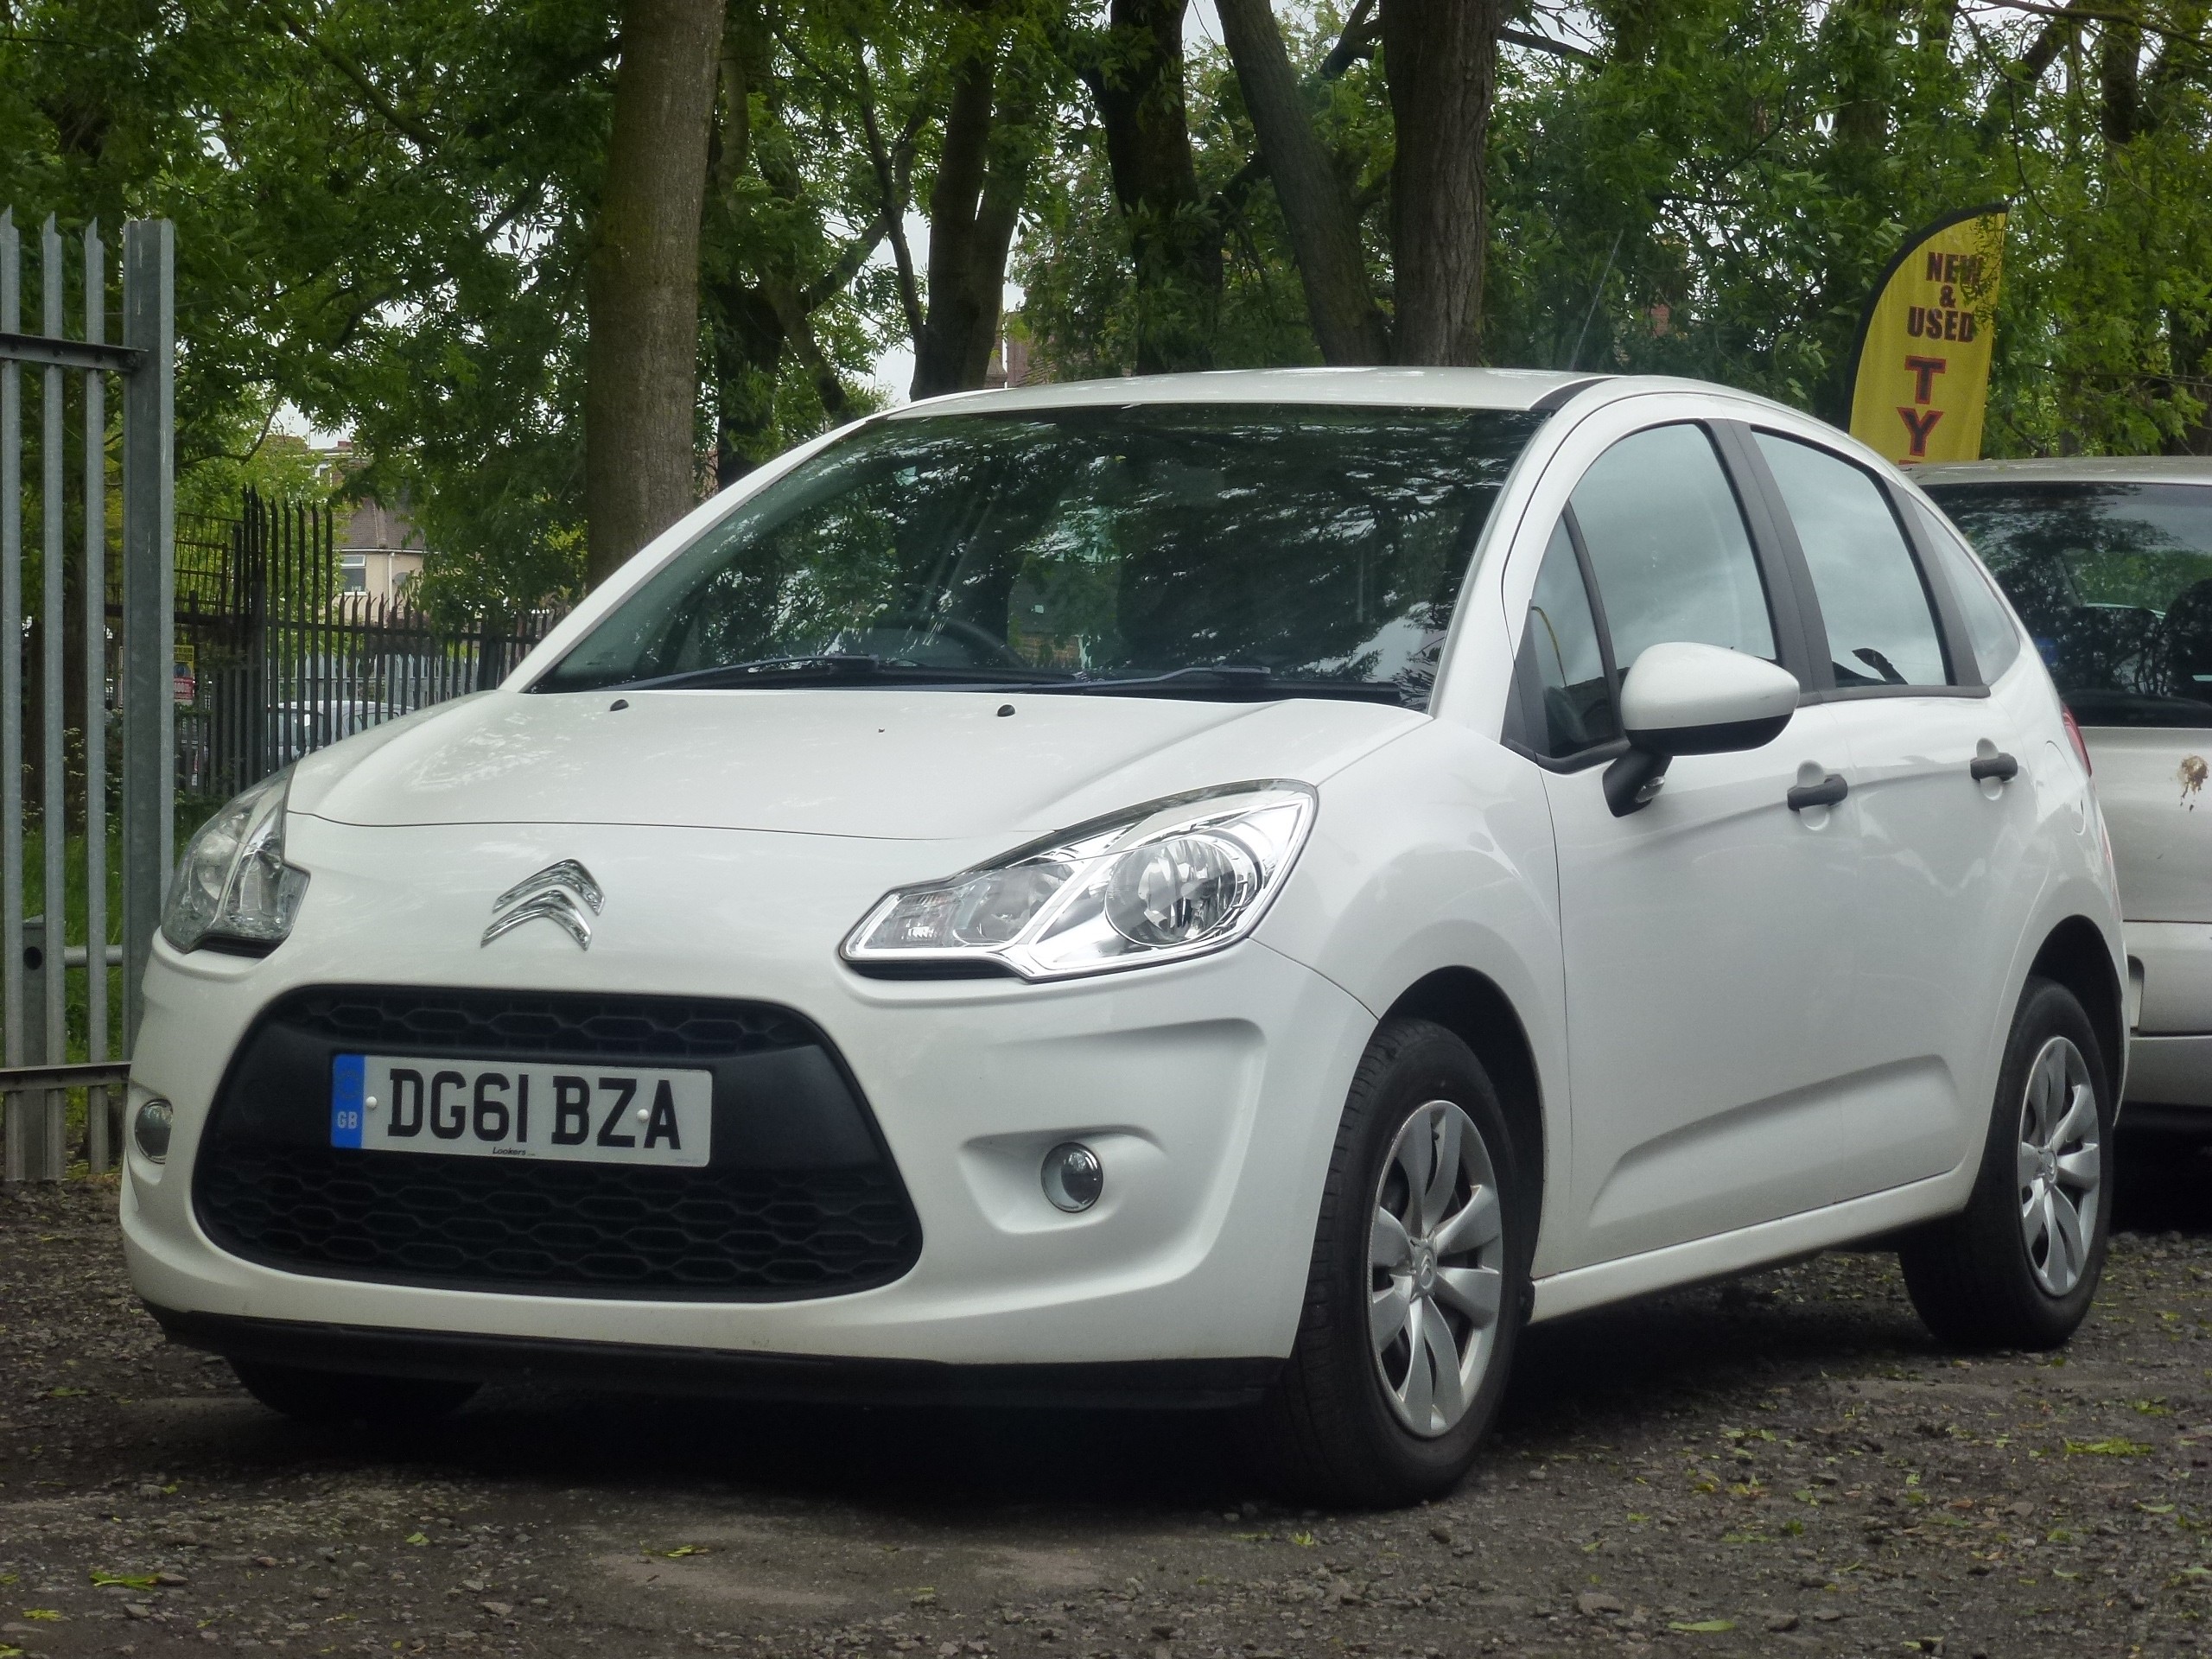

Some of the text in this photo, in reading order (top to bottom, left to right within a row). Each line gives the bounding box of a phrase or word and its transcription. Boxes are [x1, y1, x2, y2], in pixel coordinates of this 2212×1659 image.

[1926, 251, 1985, 284] NEW
[1939, 284, 1957, 308] &
[1907, 306, 1975, 343] USED
[1897, 354, 1947, 464] TY
[338, 1111, 358, 1129] GB
[388, 1068, 682, 1150] DG61 BZA
[493, 1147, 526, 1156] Lookers
